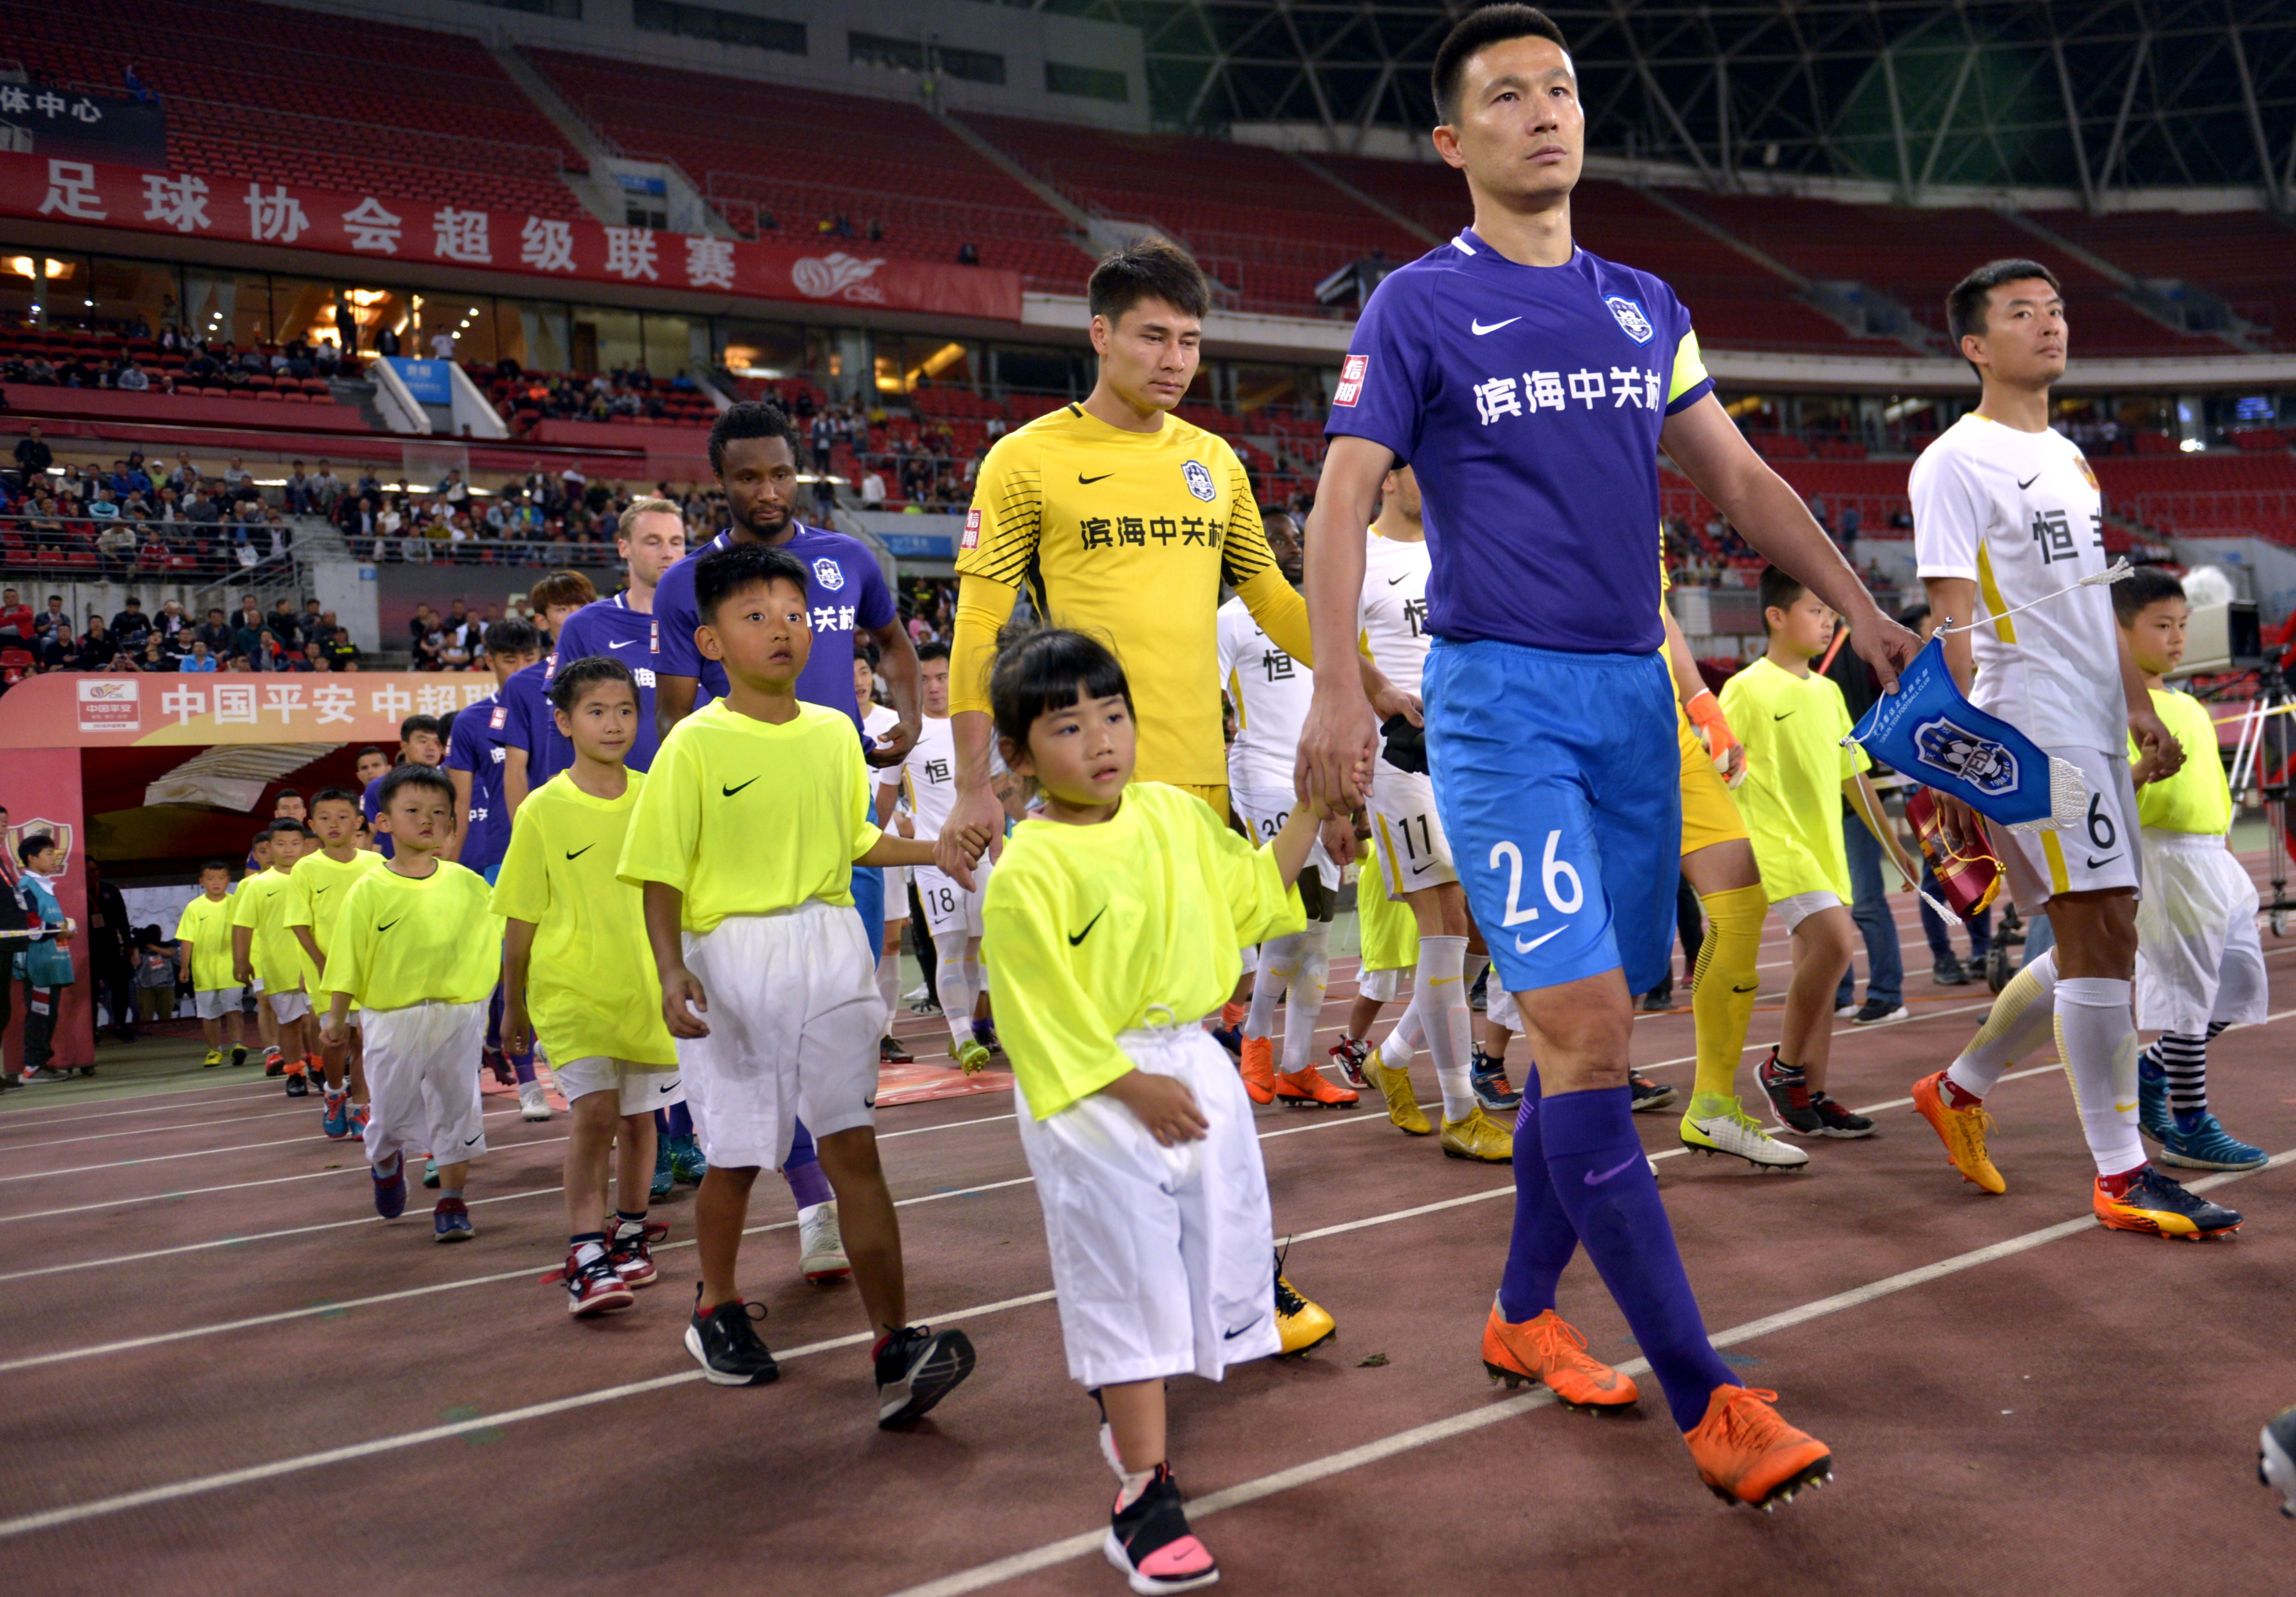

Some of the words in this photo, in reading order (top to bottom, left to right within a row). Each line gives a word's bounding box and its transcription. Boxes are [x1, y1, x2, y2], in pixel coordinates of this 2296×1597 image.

[37, 159, 736, 289] 足球协会超级联赛
[1473, 366, 1661, 425] 滨海中关村
[1080, 516, 1224, 550] 滨海中关村
[806, 605, 855, 632] 关村
[1263, 649, 1296, 682] 恒
[86, 704, 132, 713] 中国平安
[161, 683, 356, 726] 中国平安
[1879, 727, 1893, 745] TIANJIN
[1890, 714, 1901, 728] TEDA
[1898, 691, 1920, 716] FOOTBALL
[1918, 676, 1930, 691] CLUB
[925, 758, 952, 785] 恒
[1958, 741, 2004, 783] TEDA
[1990, 761, 2011, 787] 1998.2.16
[1399, 814, 1432, 860] 11
[2087, 792, 2116, 849] 6
[1489, 829, 1584, 928] 26
[928, 888, 955, 915] 18
